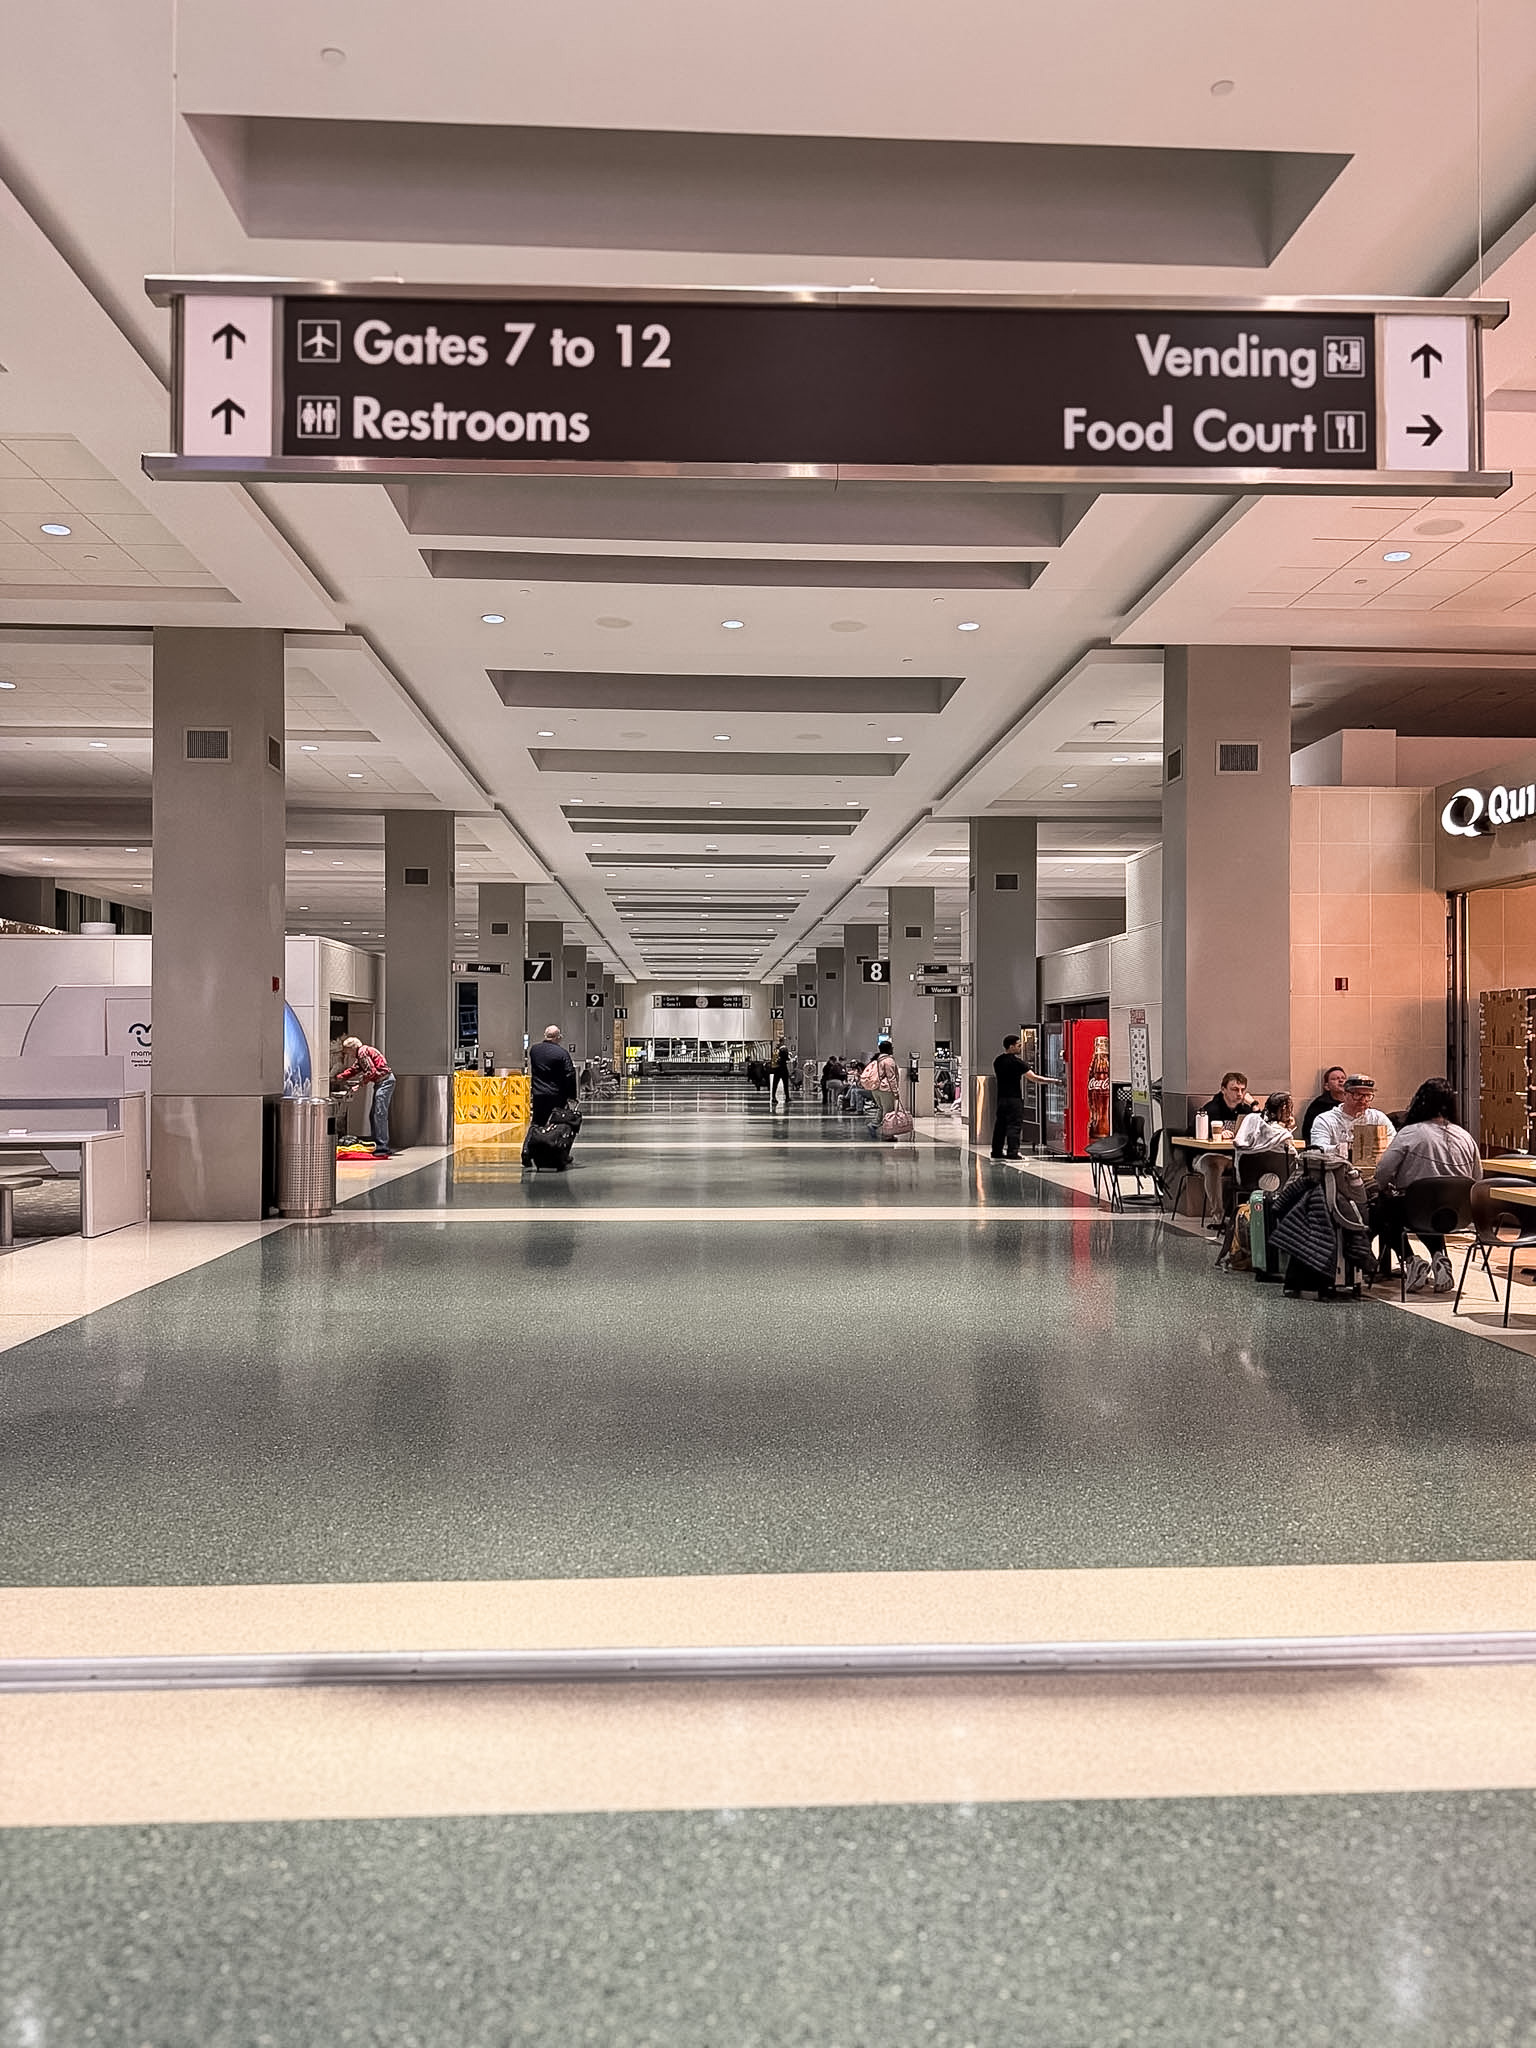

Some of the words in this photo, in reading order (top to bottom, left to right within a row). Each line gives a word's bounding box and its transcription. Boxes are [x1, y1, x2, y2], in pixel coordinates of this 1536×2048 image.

[353, 319, 489, 366] Gates
[504, 322, 536, 367] 7
[550, 328, 595, 367] to
[616, 324, 671, 368] 12
[1135, 333, 1317, 388] Vending
[353, 396, 590, 443] Restrooms
[1064, 405, 1173, 451] Food
[1193, 408, 1317, 452] Court
[1441, 787, 1484, 837] Q
[531, 961, 545, 980] 7
[871, 963, 882, 981] 8
[591, 994, 599, 1006] 9
[801, 995, 816, 1007] 10
[616, 1009, 626, 1018] 11
[771, 1009, 783, 1019] 12
